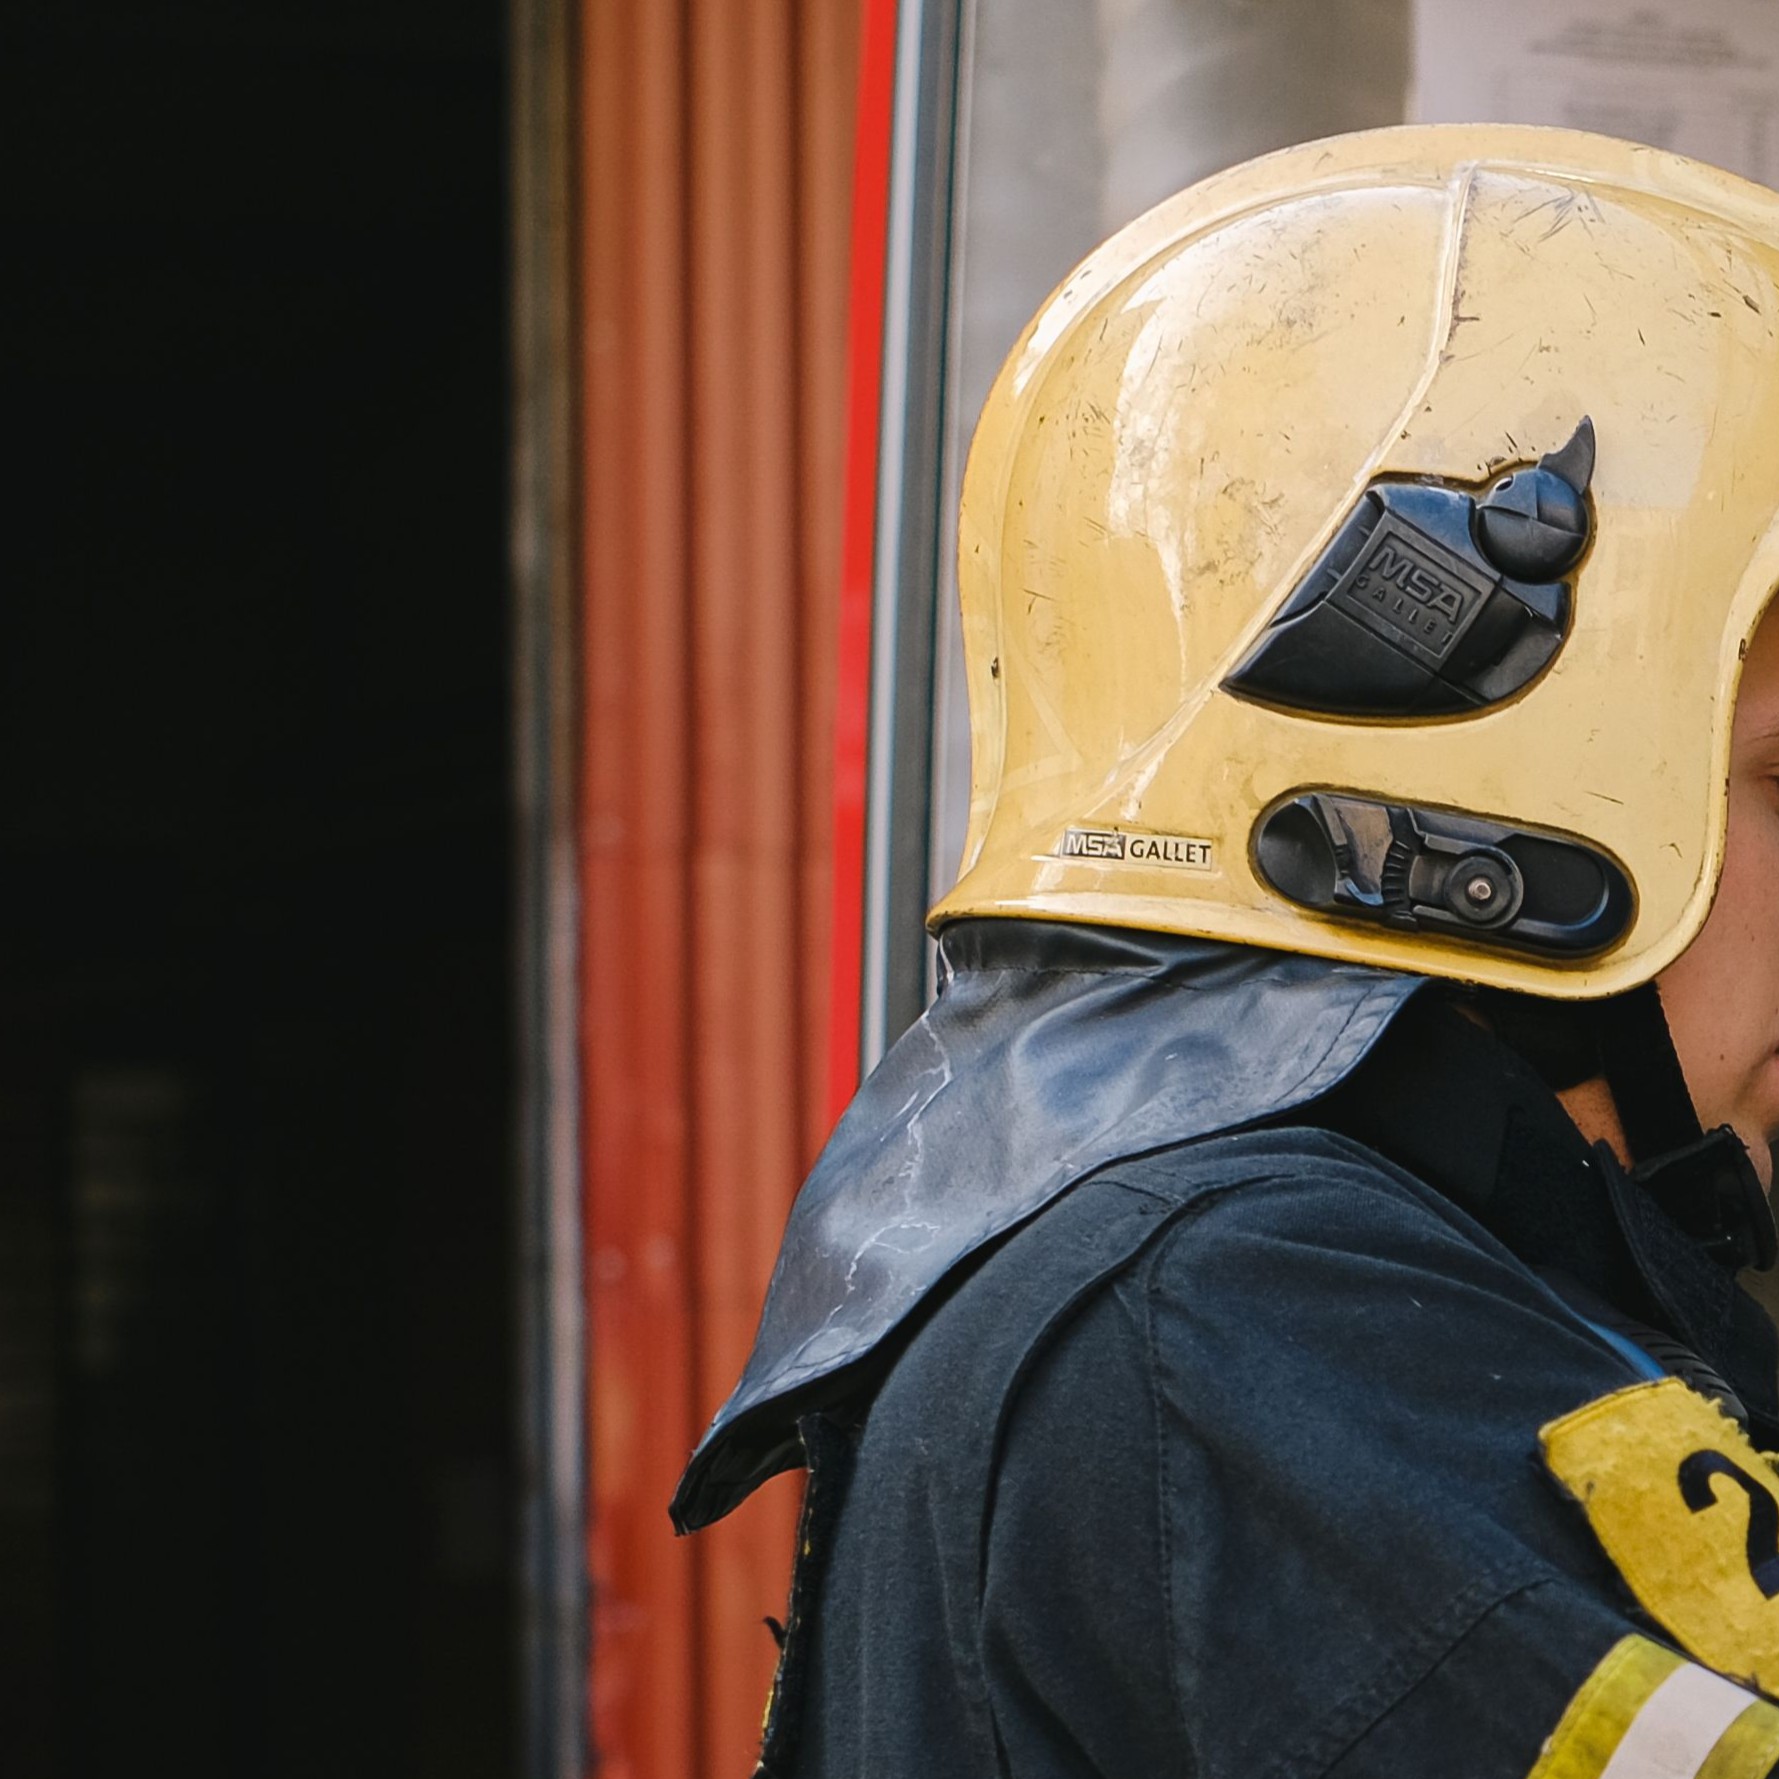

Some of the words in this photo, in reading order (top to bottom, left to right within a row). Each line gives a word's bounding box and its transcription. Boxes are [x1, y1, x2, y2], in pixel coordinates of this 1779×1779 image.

[1355, 575, 1453, 645] GALLET
[1369, 545, 1464, 623] MSA
[1065, 832, 1124, 858] MSA
[1130, 839, 1212, 864] GALLET
